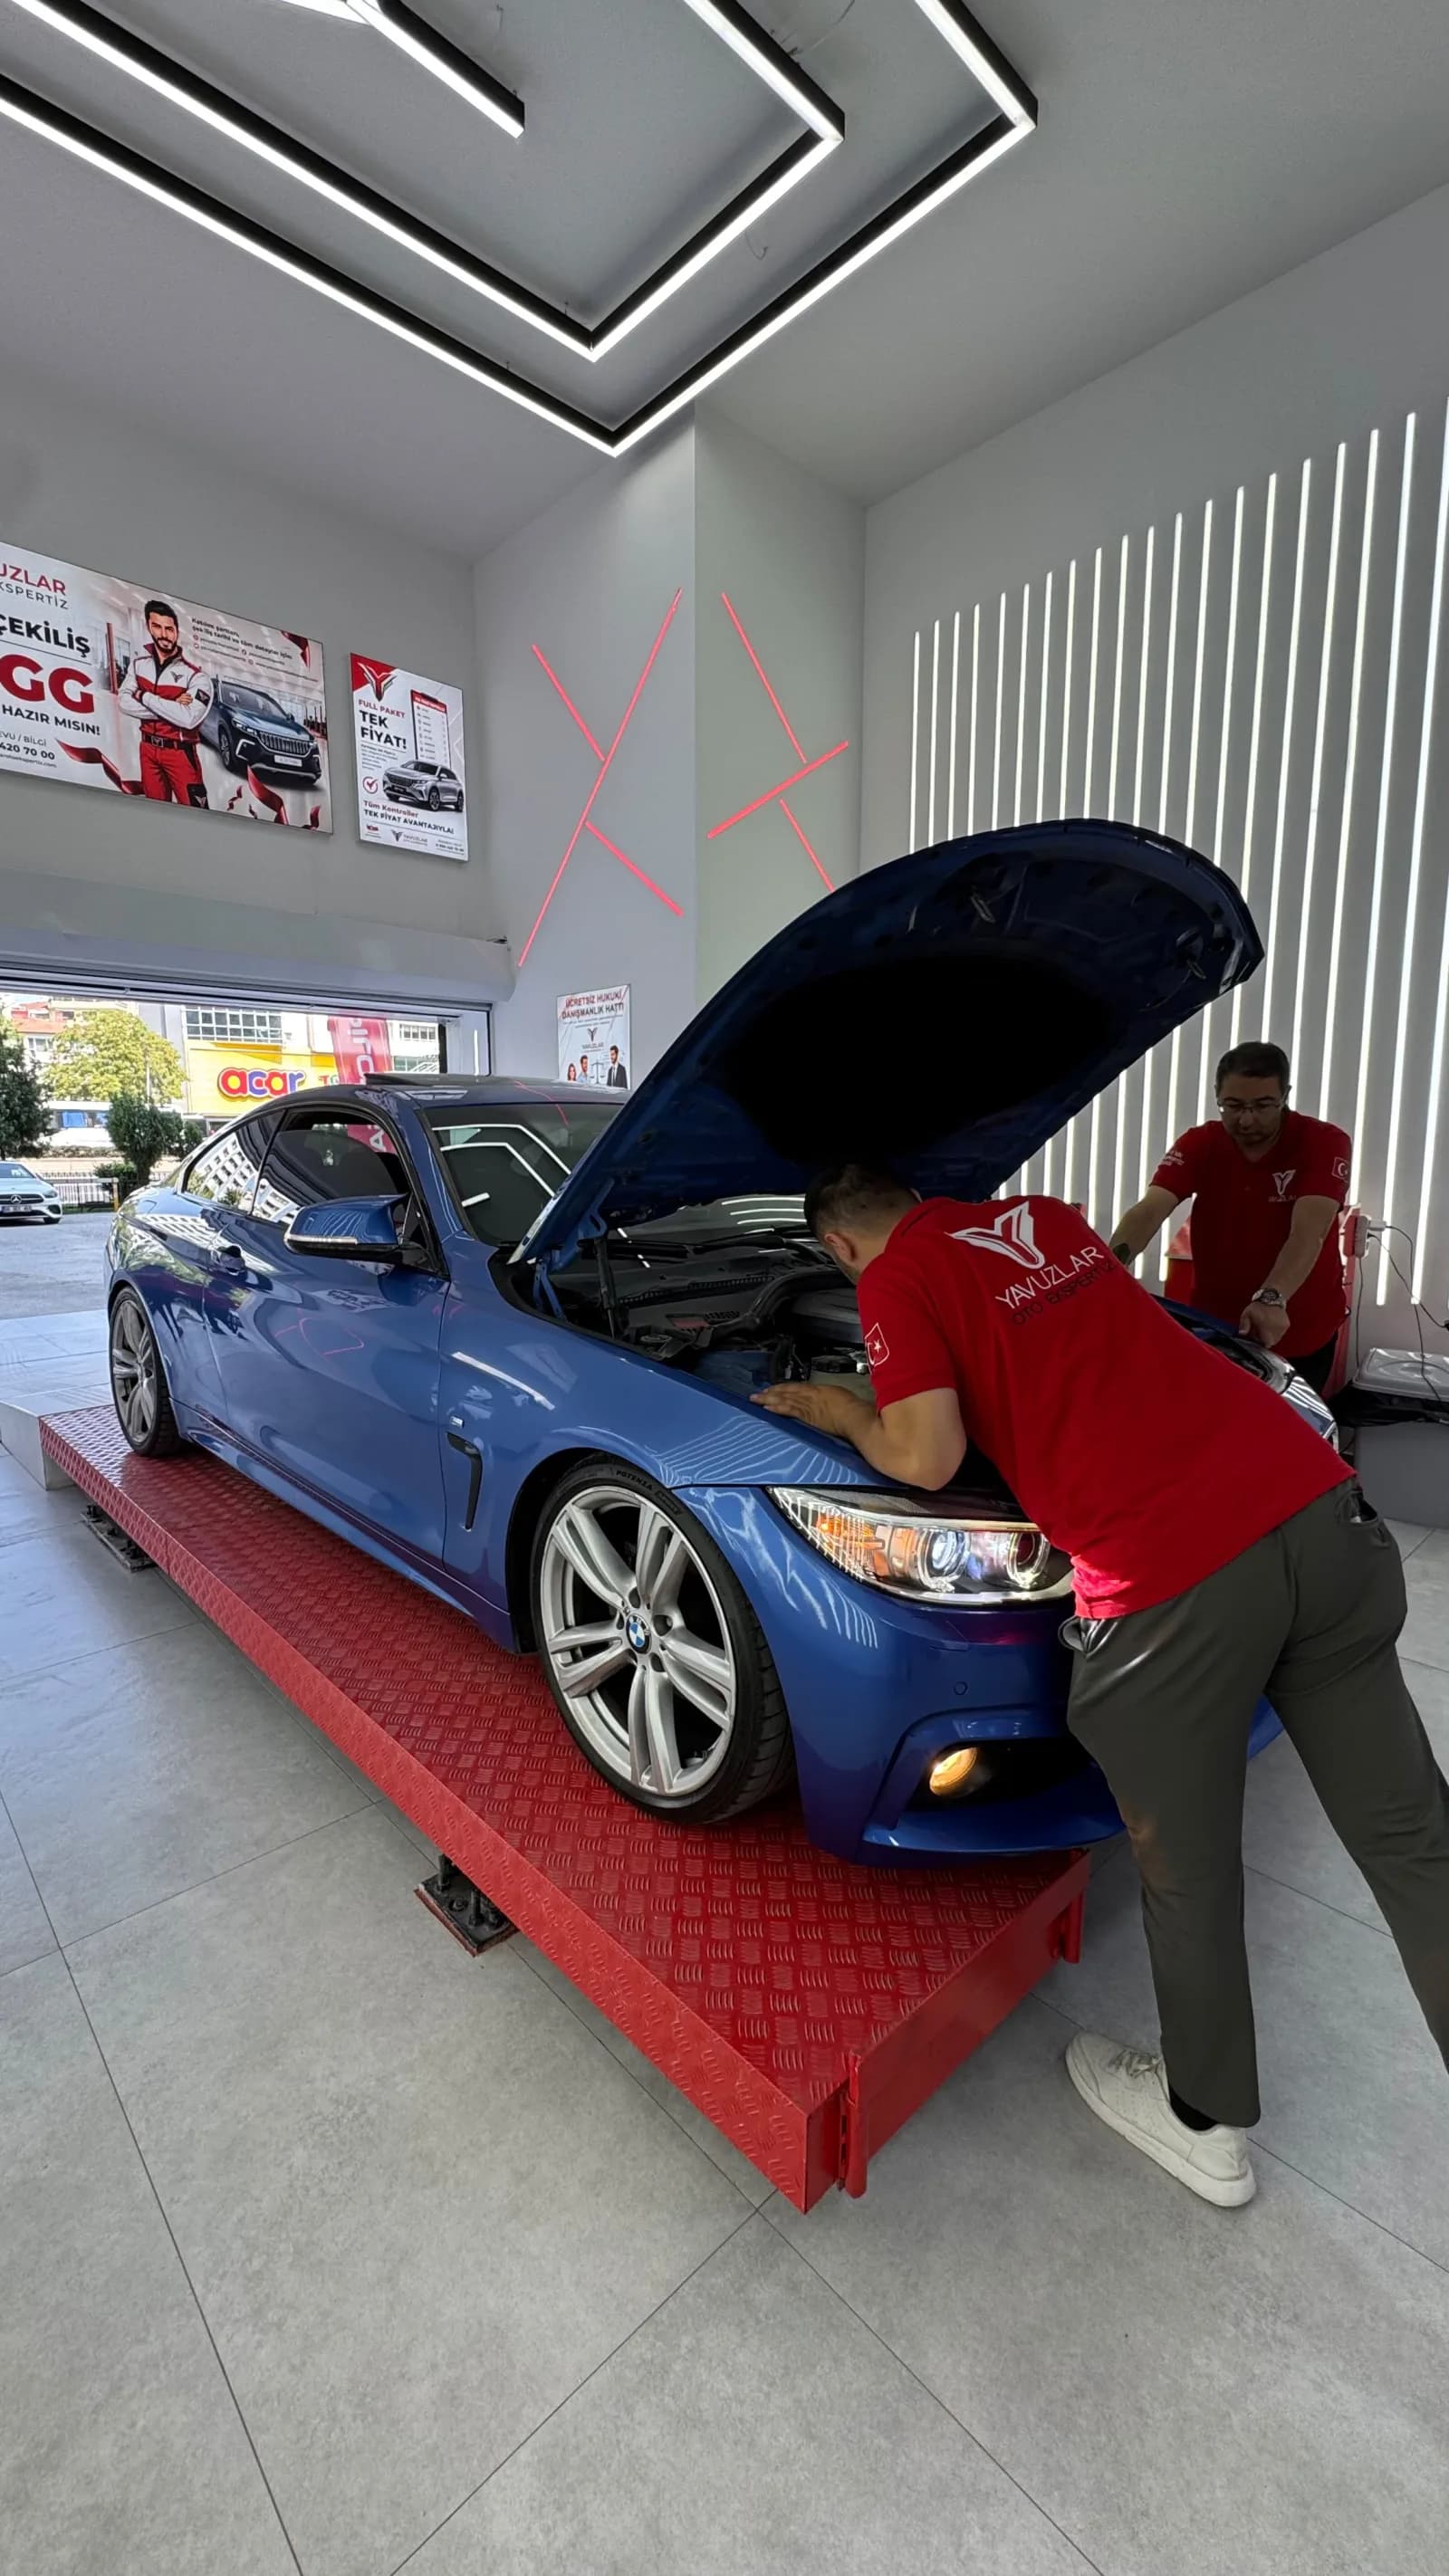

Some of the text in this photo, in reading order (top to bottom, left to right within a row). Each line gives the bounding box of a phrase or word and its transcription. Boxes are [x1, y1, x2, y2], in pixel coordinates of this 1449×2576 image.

[359, 699, 406, 718] FULL PAKET
[2, 704, 101, 736] HAZIR MISIN!
[359, 710, 389, 729] TEK
[360, 725, 407, 750] FİYAT!
[23, 746, 37, 757] 70
[41, 751, 55, 761] 00
[363, 800, 380, 809] Tüm
[364, 809, 379, 818] TEK
[219, 1068, 305, 1096] acar
[994, 1246, 1105, 1309] YAVUZLAR
[1012, 1301, 1043, 1326] OTO
[616, 1470, 653, 1490] POTENZA
